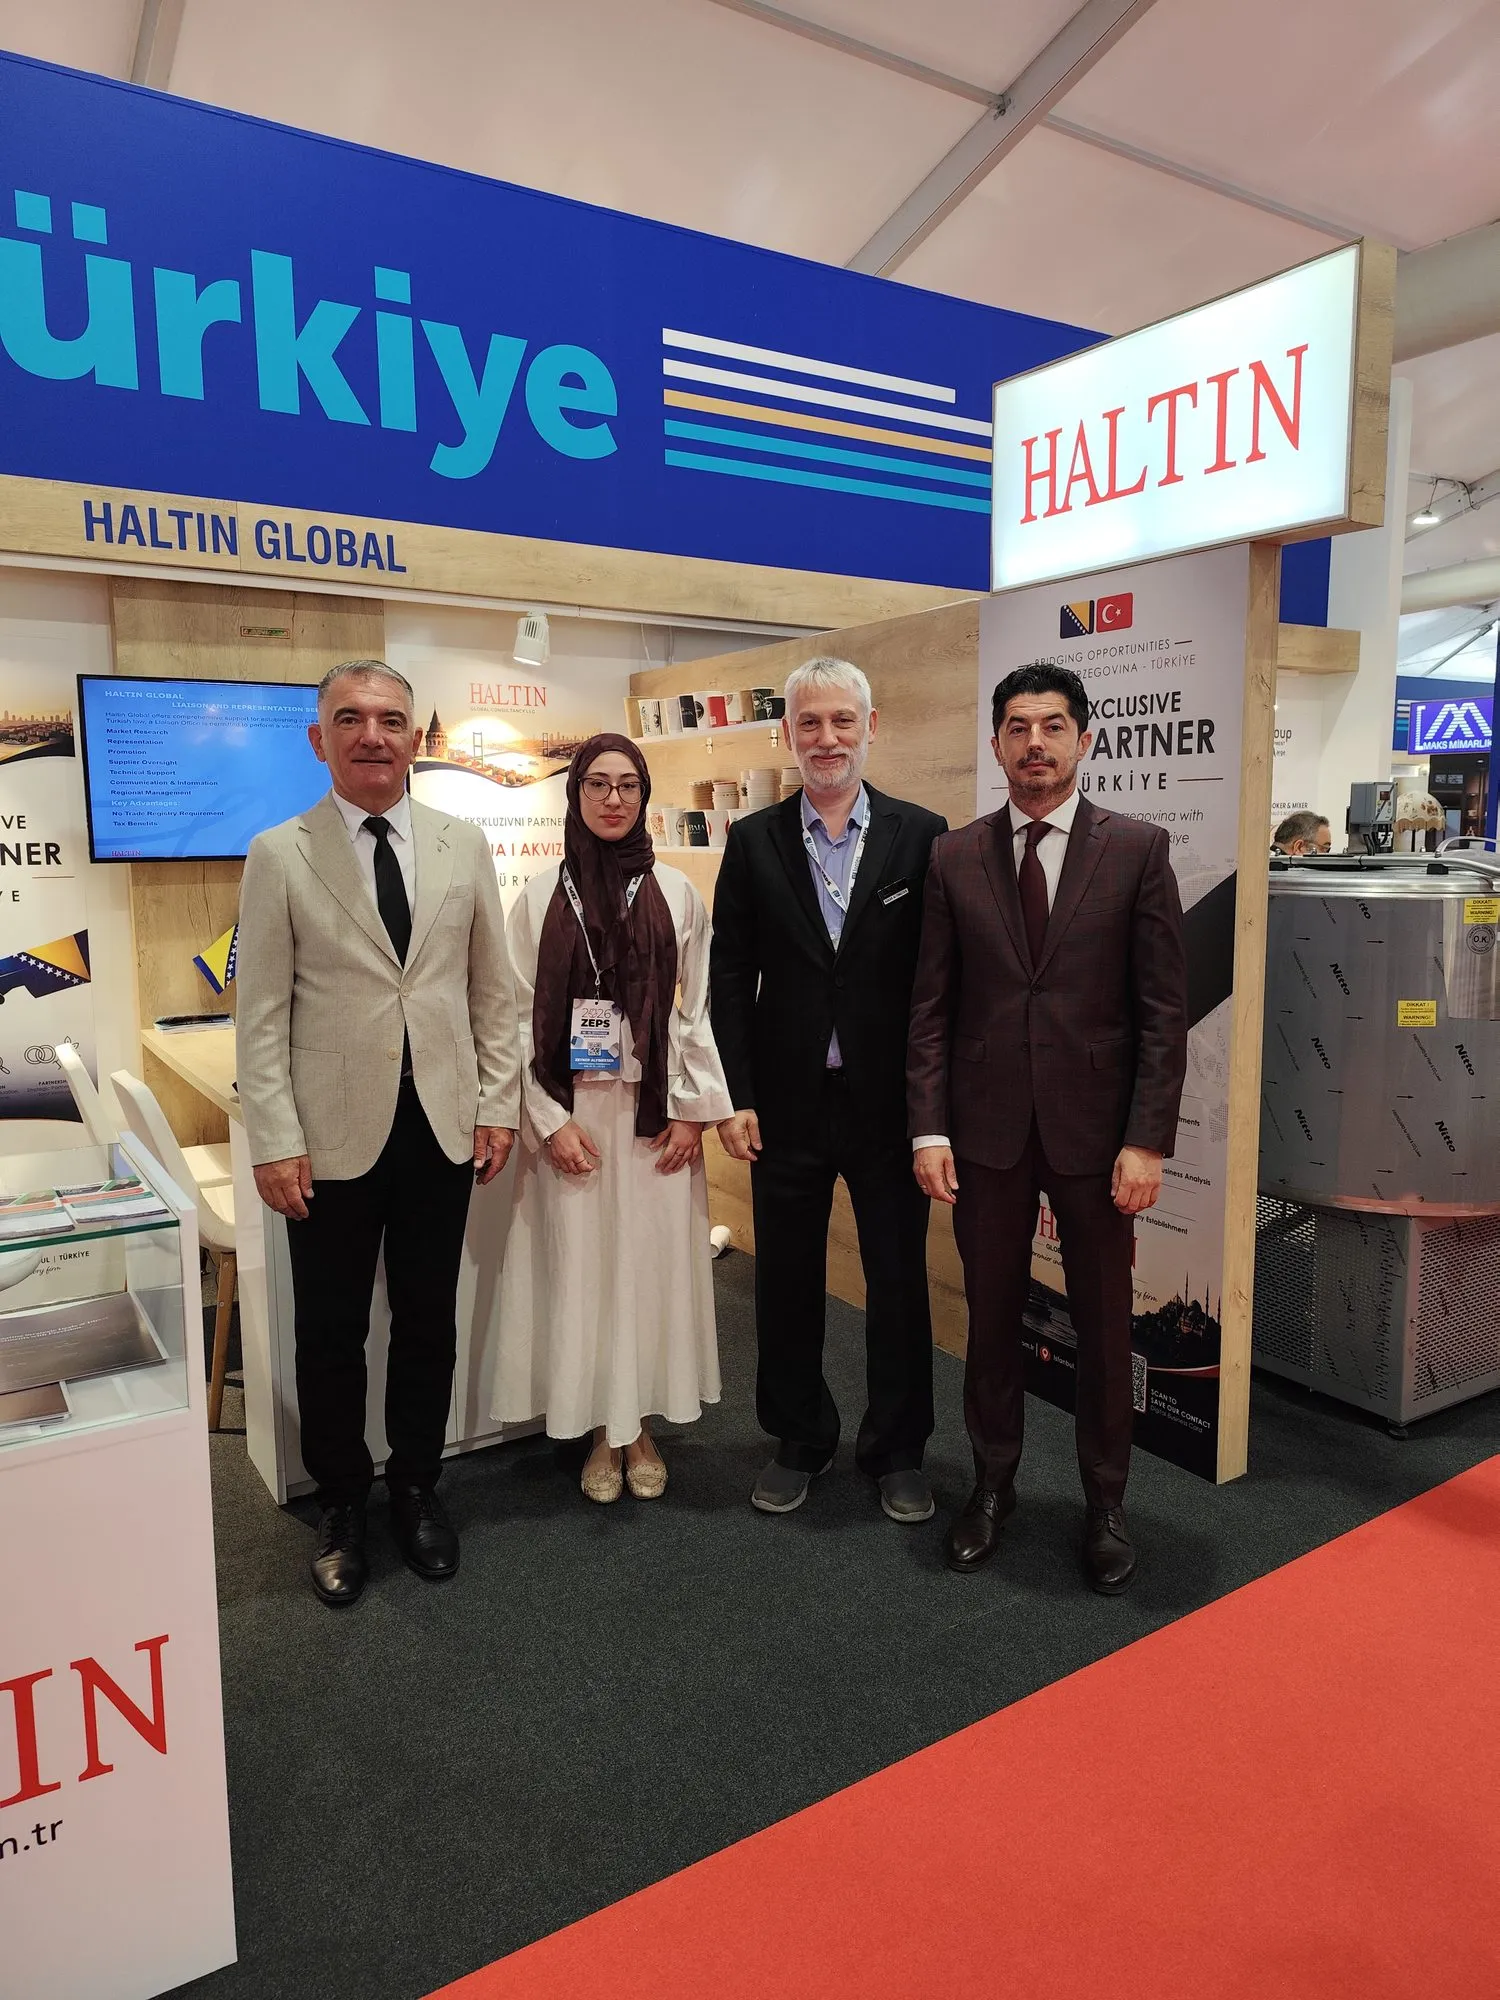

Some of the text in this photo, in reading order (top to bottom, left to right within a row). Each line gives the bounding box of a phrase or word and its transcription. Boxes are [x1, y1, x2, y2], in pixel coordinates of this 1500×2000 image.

[1020, 343, 1308, 525] HALTIN
[83, 500, 406, 572] HALTIN GLOBAL
[1088, 639, 1170, 660] OPPORTUNITIES
[1072, 663, 1138, 680] RZEGOVINA
[1151, 654, 1196, 670] TÜRKİYE
[469, 682, 546, 707] HALTIN
[231, 704, 303, 712] REPRESENTATION
[1423, 741, 1447, 750] MAKS
[1180, 809, 1204, 822] with
[0, 843, 62, 866] NER
[1329, 963, 1351, 996] Nitto
[581, 1019, 611, 1028] ZEPS
[1311, 1037, 1331, 1070] Nitto
[1455, 1044, 1475, 1076] Nitto
[1294, 1109, 1313, 1141] Nitto
[1435, 1120, 1456, 1153] Nitto
[1185, 1173, 1211, 1187] Analysis
[1039, 1205, 1060, 1243] H
[1146, 1216, 1188, 1235] Establishment
[59, 1251, 90, 1261] TÜRKİYE
[1151, 1389, 1177, 1405] SCAN TO
[1151, 1397, 1211, 1429] SAVE OUR CONTACT
